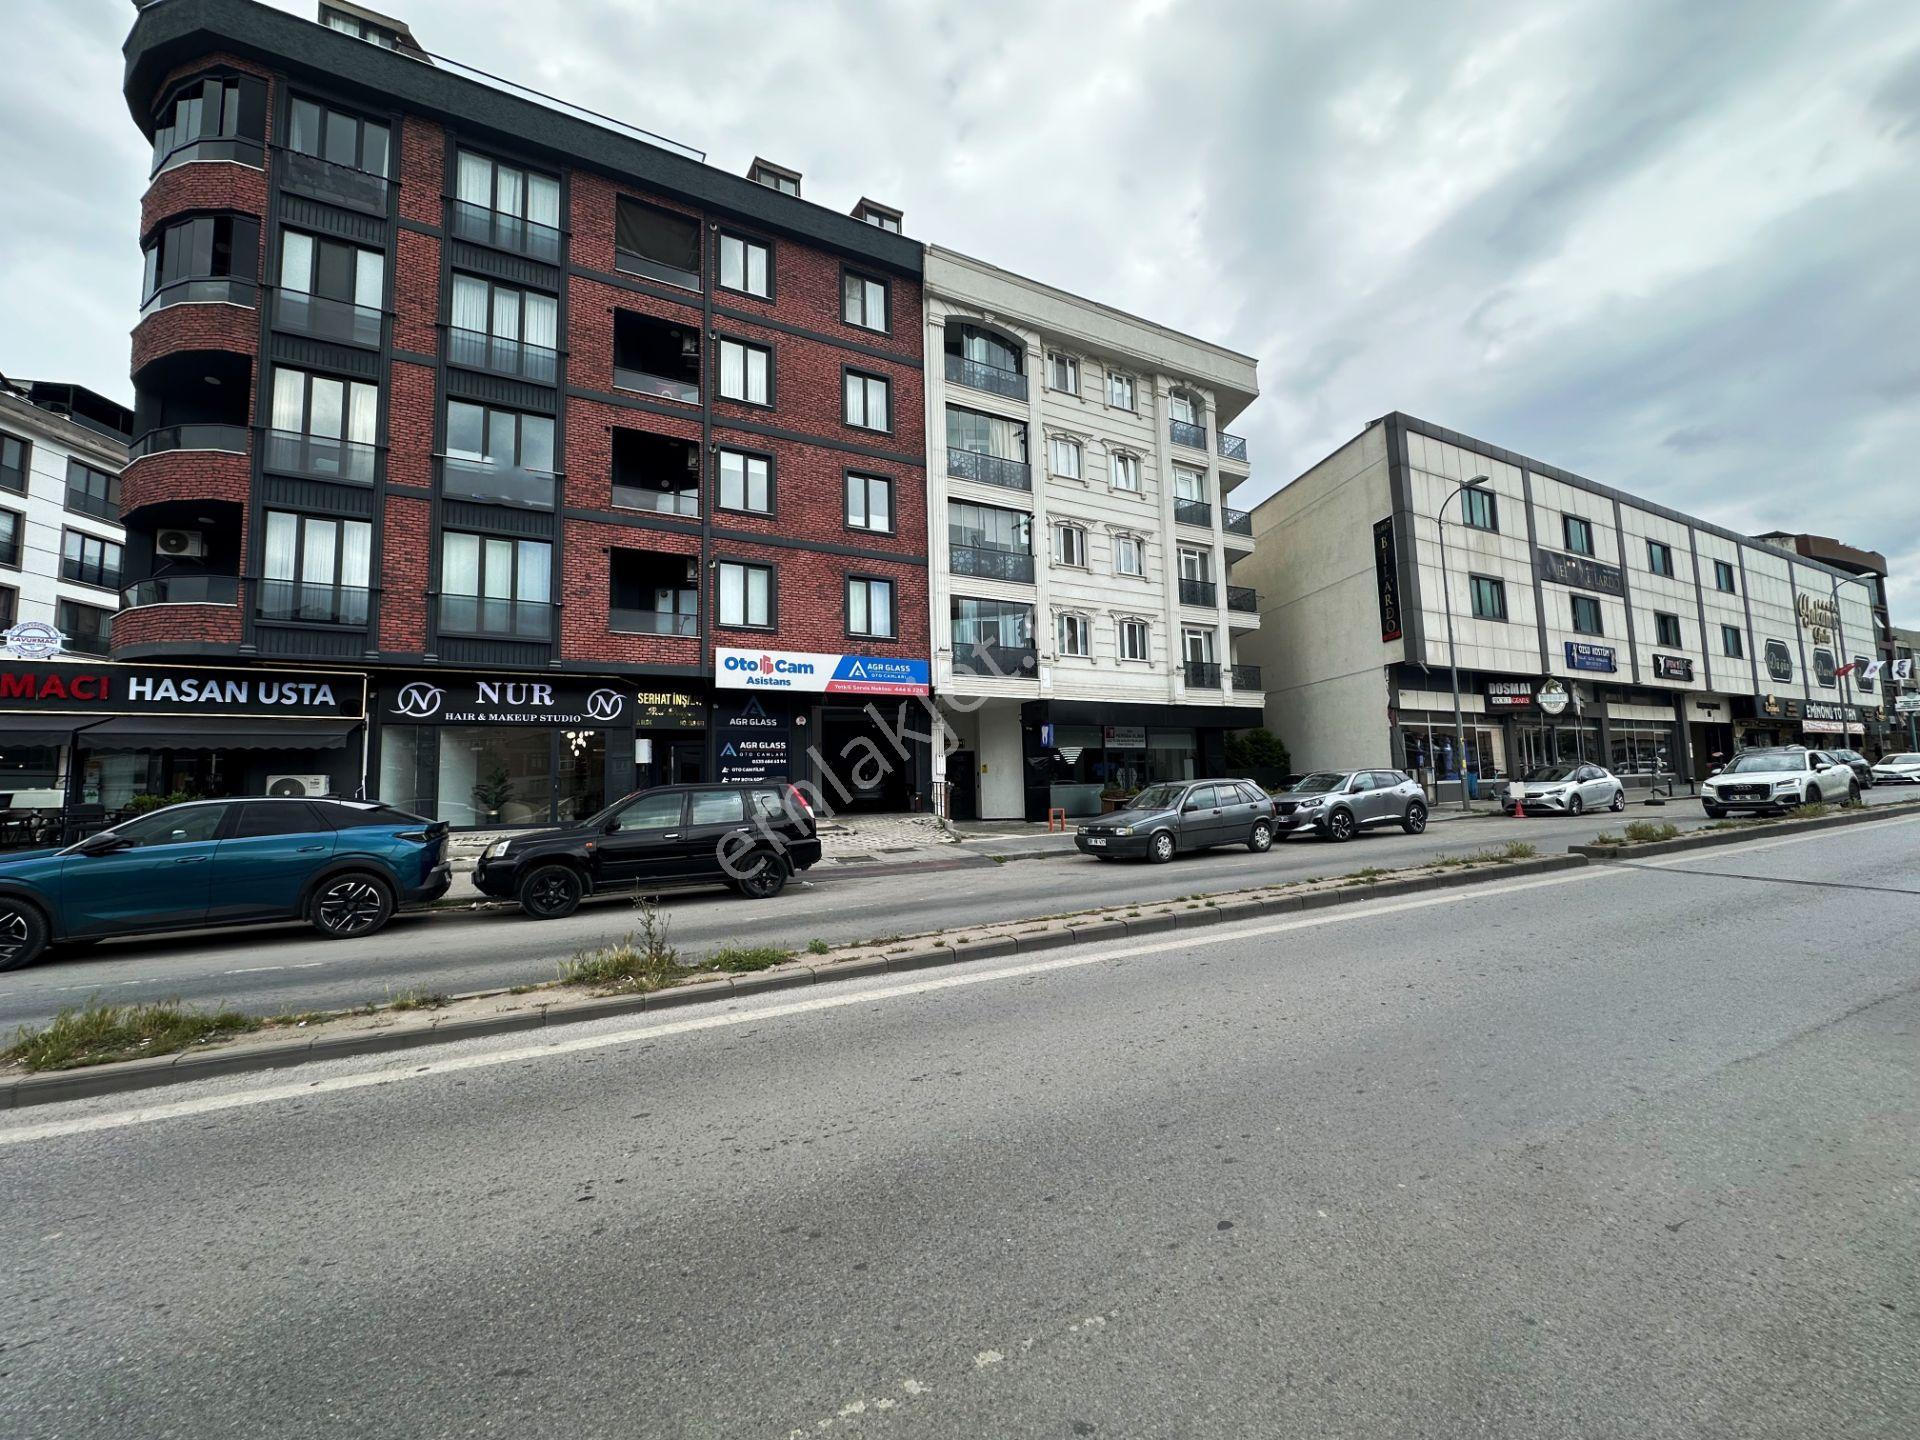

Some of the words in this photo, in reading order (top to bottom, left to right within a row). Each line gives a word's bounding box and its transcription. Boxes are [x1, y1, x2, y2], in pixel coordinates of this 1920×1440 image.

[724, 656, 758, 672] Oto
[774, 659, 814, 675] Cam
[867, 663, 883, 671] AGR
[885, 664, 911, 672] GLASS
[746, 676, 792, 687] Asistans
[0, 672, 110, 700] MACI
[128, 677, 248, 703] HASAN
[258, 682, 336, 706] USTA
[475, 681, 555, 706] NUR
[637, 692, 672, 705] SERHAT
[445, 712, 476, 721] HAIR
[477, 713, 486, 722] &
[488, 713, 538, 722] MAKEUP
[539, 714, 582, 723] STUDIO
[729, 718, 748, 726] AGR
[749, 718, 777, 726] GLASS
[740, 741, 758, 749] AGR
